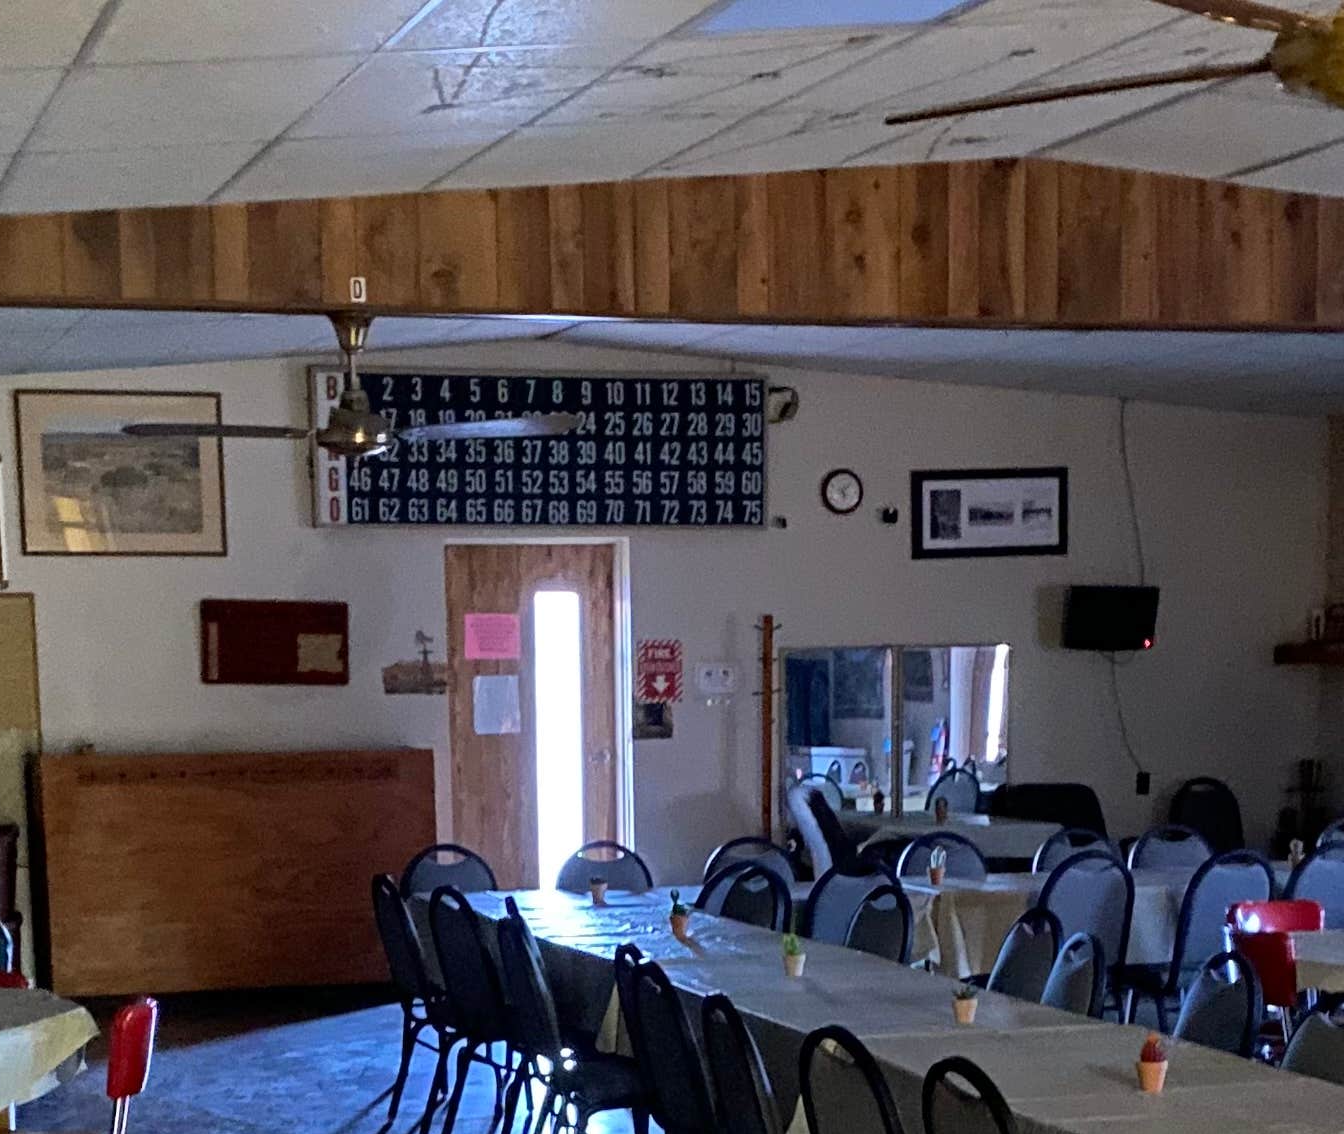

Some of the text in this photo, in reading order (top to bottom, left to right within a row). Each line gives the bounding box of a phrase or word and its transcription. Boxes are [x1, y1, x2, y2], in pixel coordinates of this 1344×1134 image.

[327, 376, 759, 407] B 2 3 4 5 6 7 8 9 10 11 12 13 14 15
[574, 411, 595, 435] 24
[604, 411, 624, 435] 25
[632, 412, 652, 436] 26
[660, 412, 679, 436] 27
[687, 412, 707, 436] 28
[715, 413, 734, 437] 29
[742, 413, 761, 437] 30
[408, 438, 428, 461] 33
[436, 439, 457, 462] 34
[464, 439, 486, 463] 35
[493, 440, 514, 463] 36
[522, 440, 541, 464] 37
[548, 440, 568, 464] 38
[576, 441, 596, 464] 39
[604, 441, 625, 465] 40
[634, 442, 650, 465] 41
[660, 442, 680, 465] 42
[687, 442, 707, 465] 43
[714, 443, 734, 466] 44
[742, 443, 762, 466] 45
[328, 467, 762, 495] G 46 47 48 49 50 51 52 53 54 55 56 57 58 59 60
[352, 498, 368, 521] 61
[379, 498, 399, 521] 62
[409, 498, 428, 521] 63
[437, 499, 457, 522] 64
[465, 499, 486, 523] 65
[493, 499, 514, 523] 66
[521, 499, 542, 523] 67
[548, 499, 568, 523] 68
[576, 500, 596, 524] 69
[605, 500, 624, 524] 70
[634, 500, 650, 524] 71
[661, 500, 679, 524] 72
[689, 501, 706, 525] 73
[715, 501, 733, 525] 74
[742, 501, 761, 525] 75
